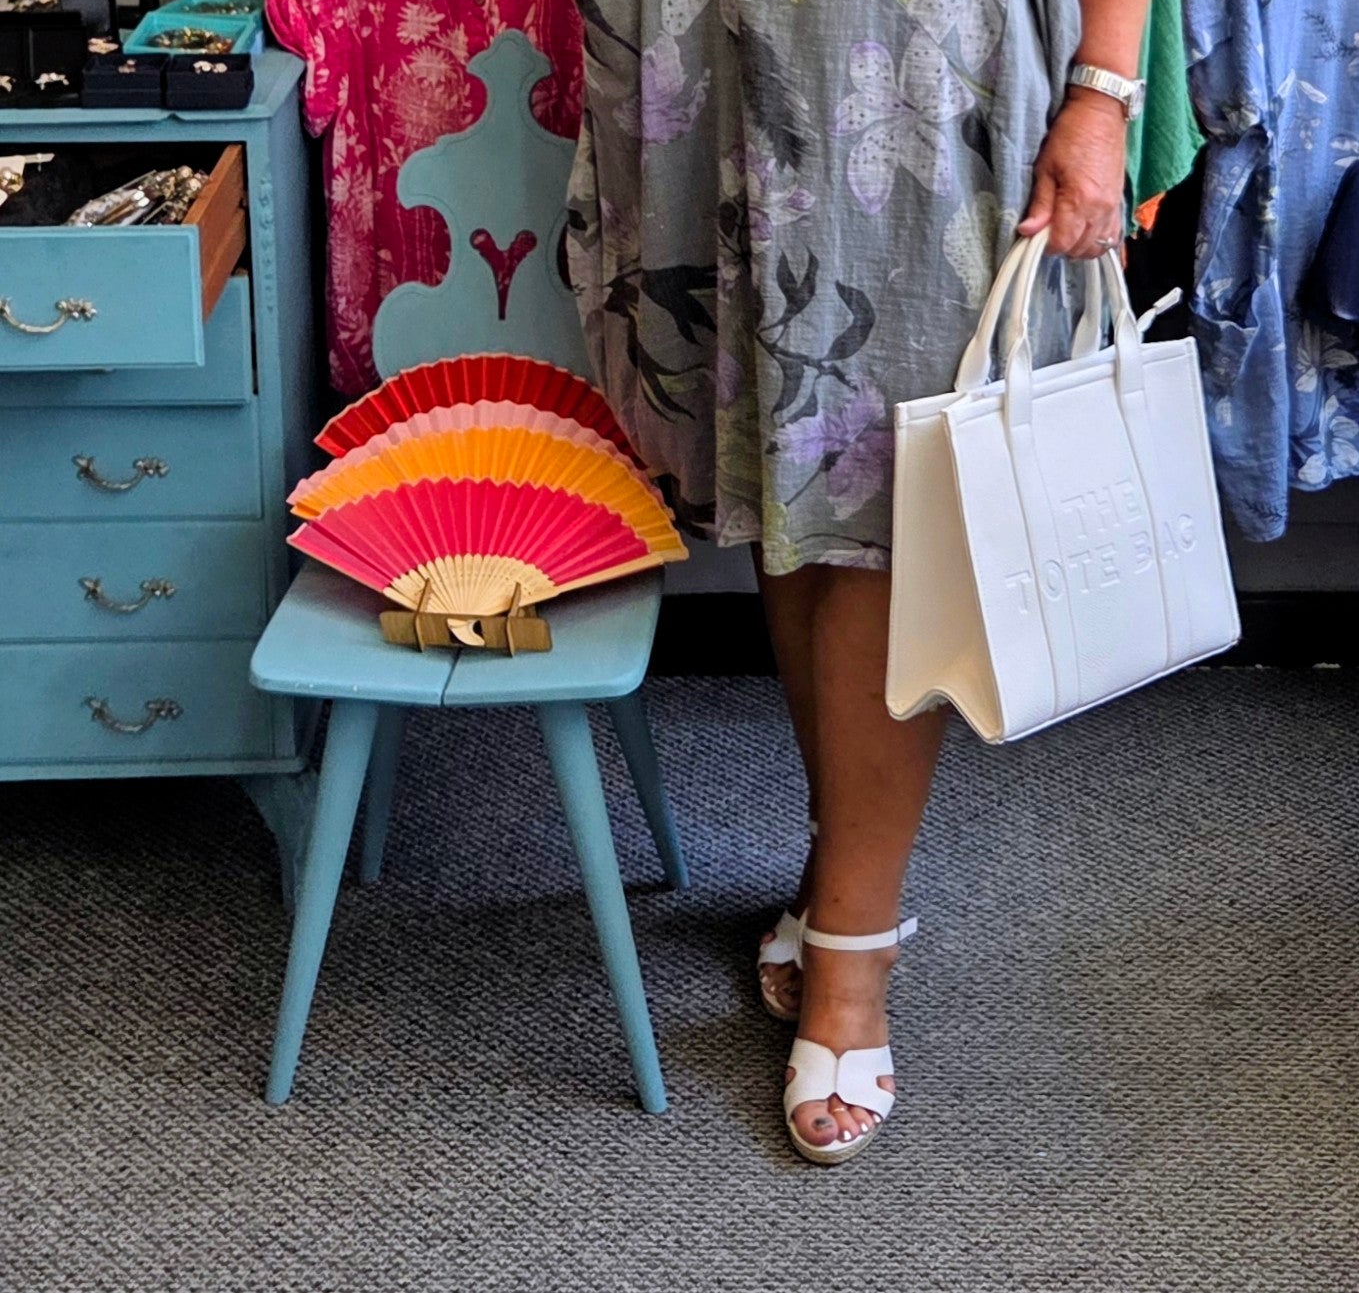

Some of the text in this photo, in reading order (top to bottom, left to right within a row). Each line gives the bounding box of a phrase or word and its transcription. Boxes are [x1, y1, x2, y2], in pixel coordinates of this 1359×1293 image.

[1060, 478, 1143, 540] THE
[1004, 513, 1197, 614] TOTE BAG
